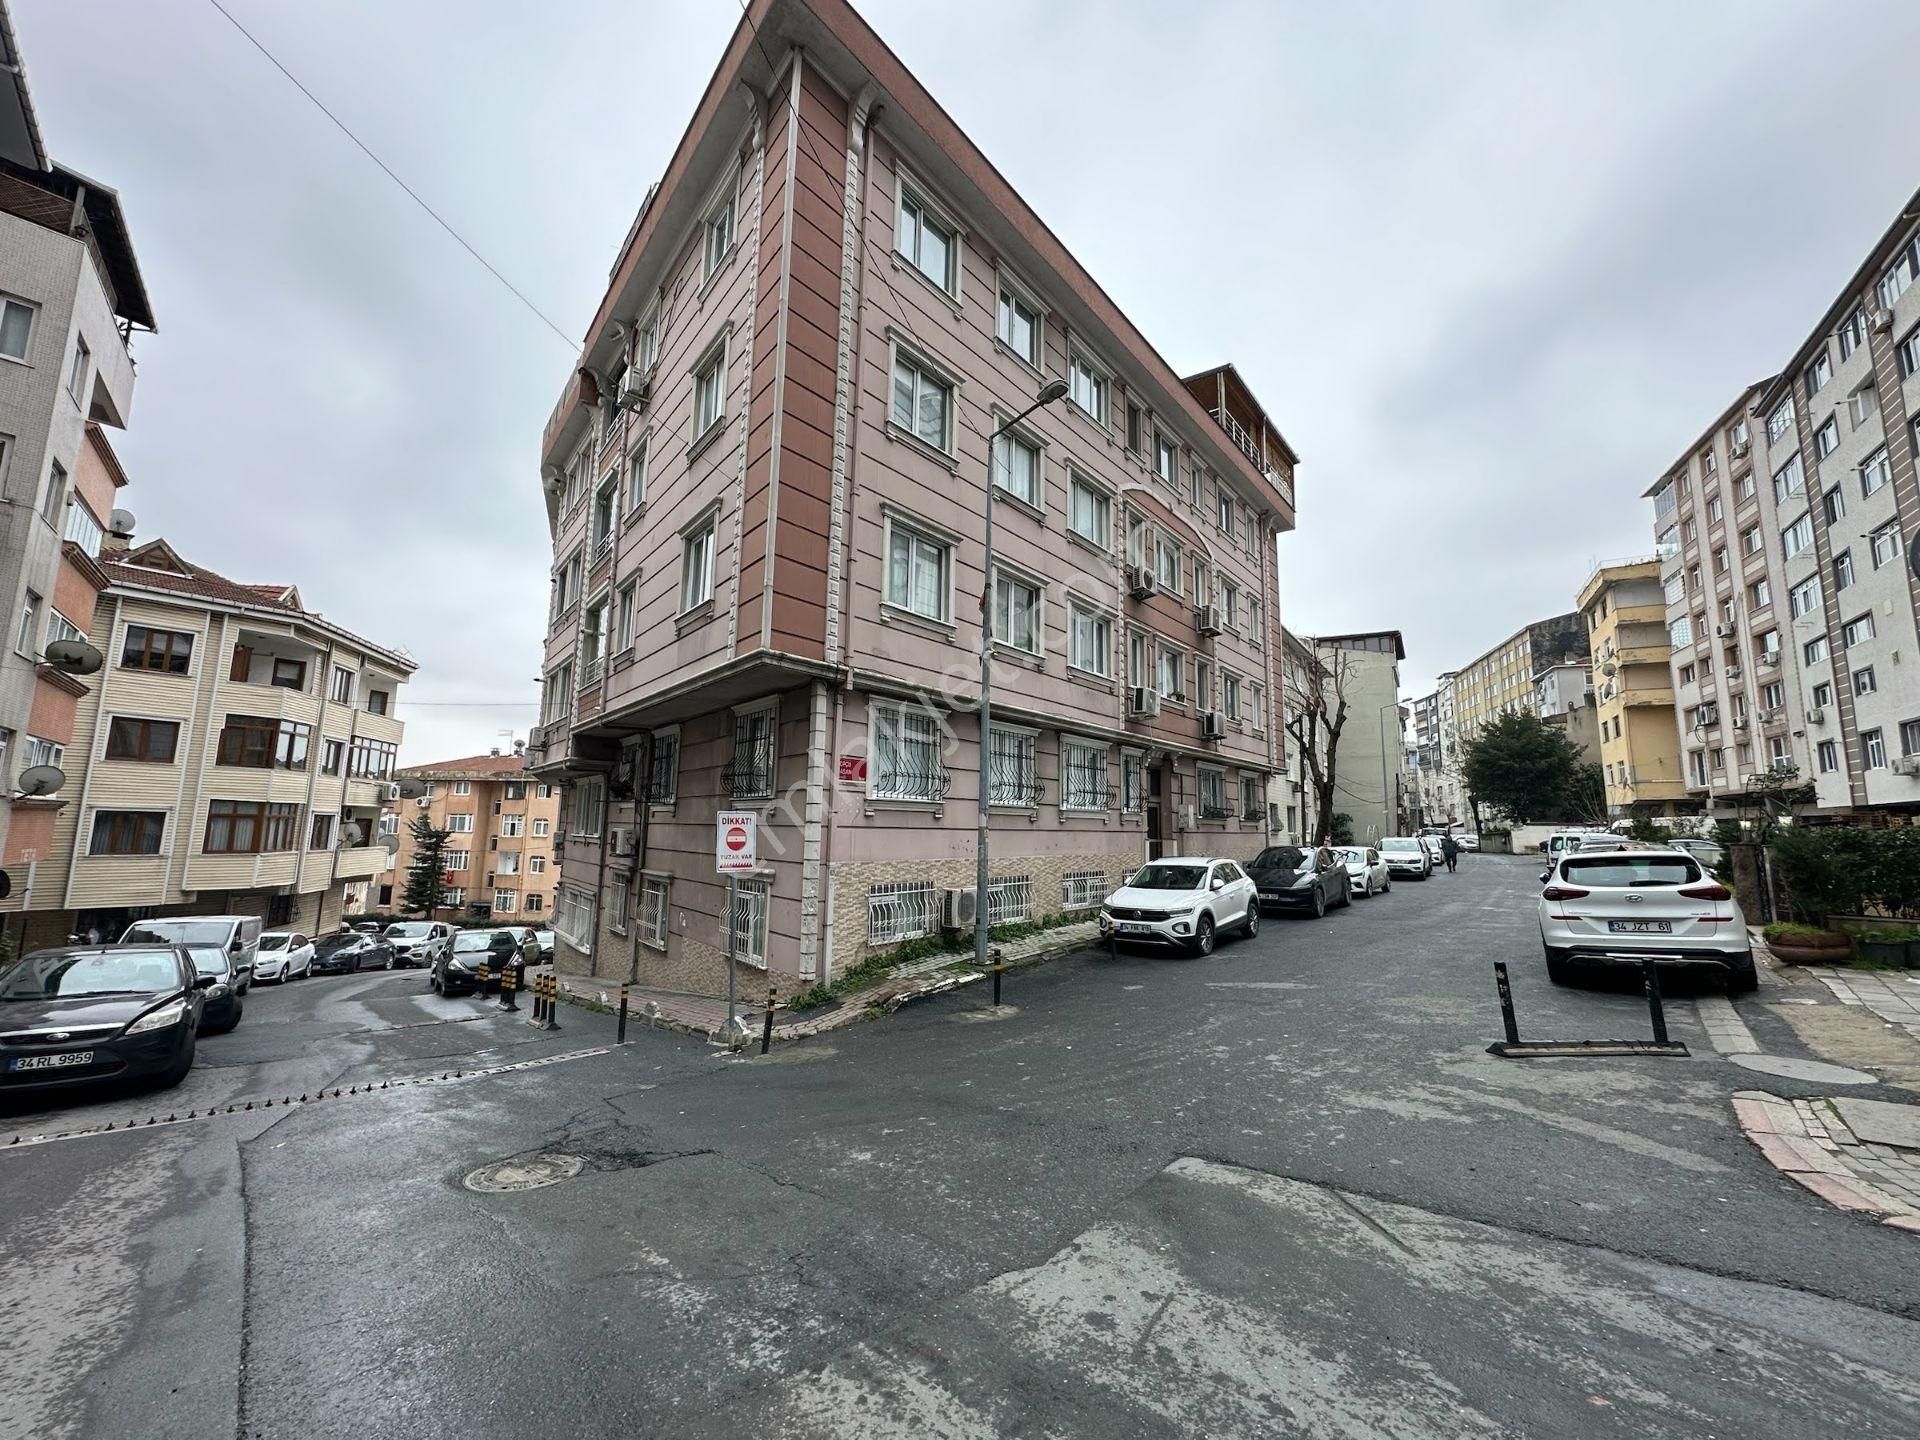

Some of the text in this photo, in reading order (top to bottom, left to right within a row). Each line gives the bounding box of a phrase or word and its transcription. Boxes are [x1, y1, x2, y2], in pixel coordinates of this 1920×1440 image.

[1614, 922, 1669, 931] 34 JZT 61
[17, 1052, 93, 1069] 34 RL 9959
